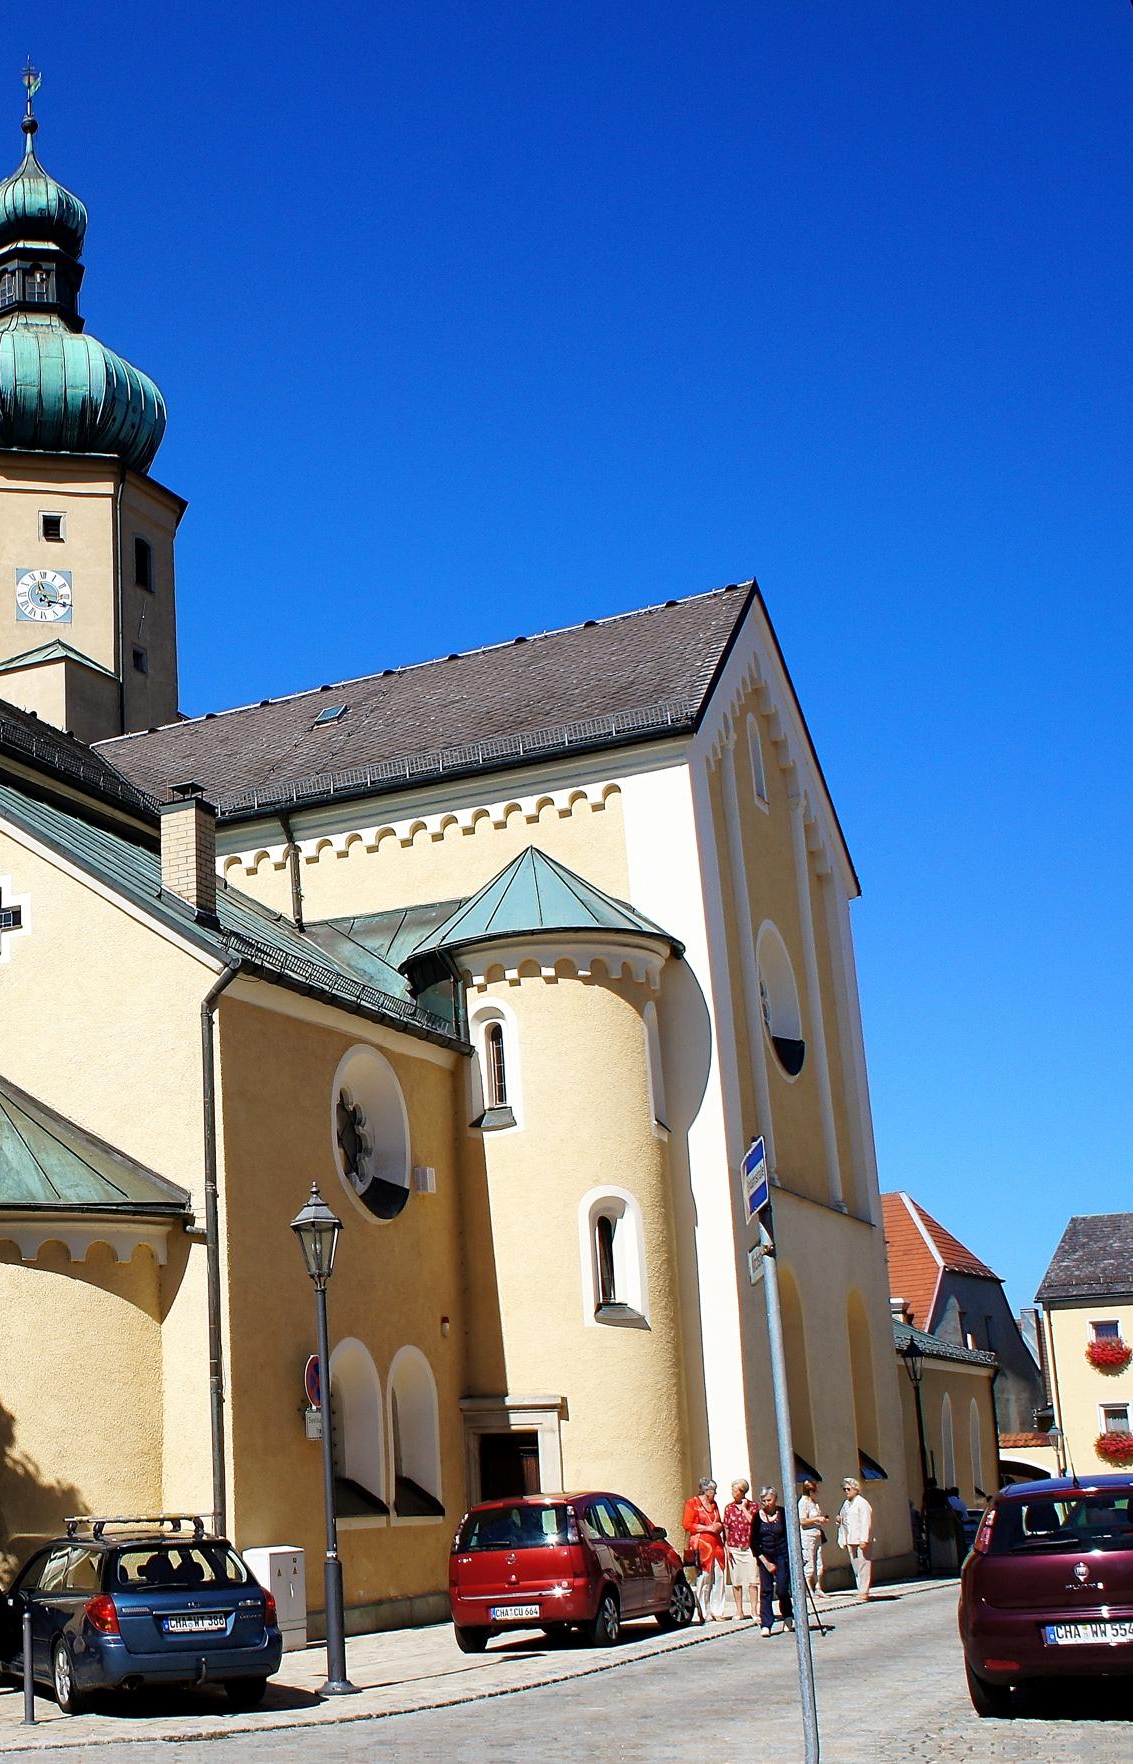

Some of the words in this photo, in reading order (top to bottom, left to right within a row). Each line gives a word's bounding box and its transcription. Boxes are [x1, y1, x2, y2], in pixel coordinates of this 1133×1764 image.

[496, 1608, 509, 1617] CHA
[169, 1616, 188, 1629] CHA
[1056, 1624, 1082, 1639] CHA
